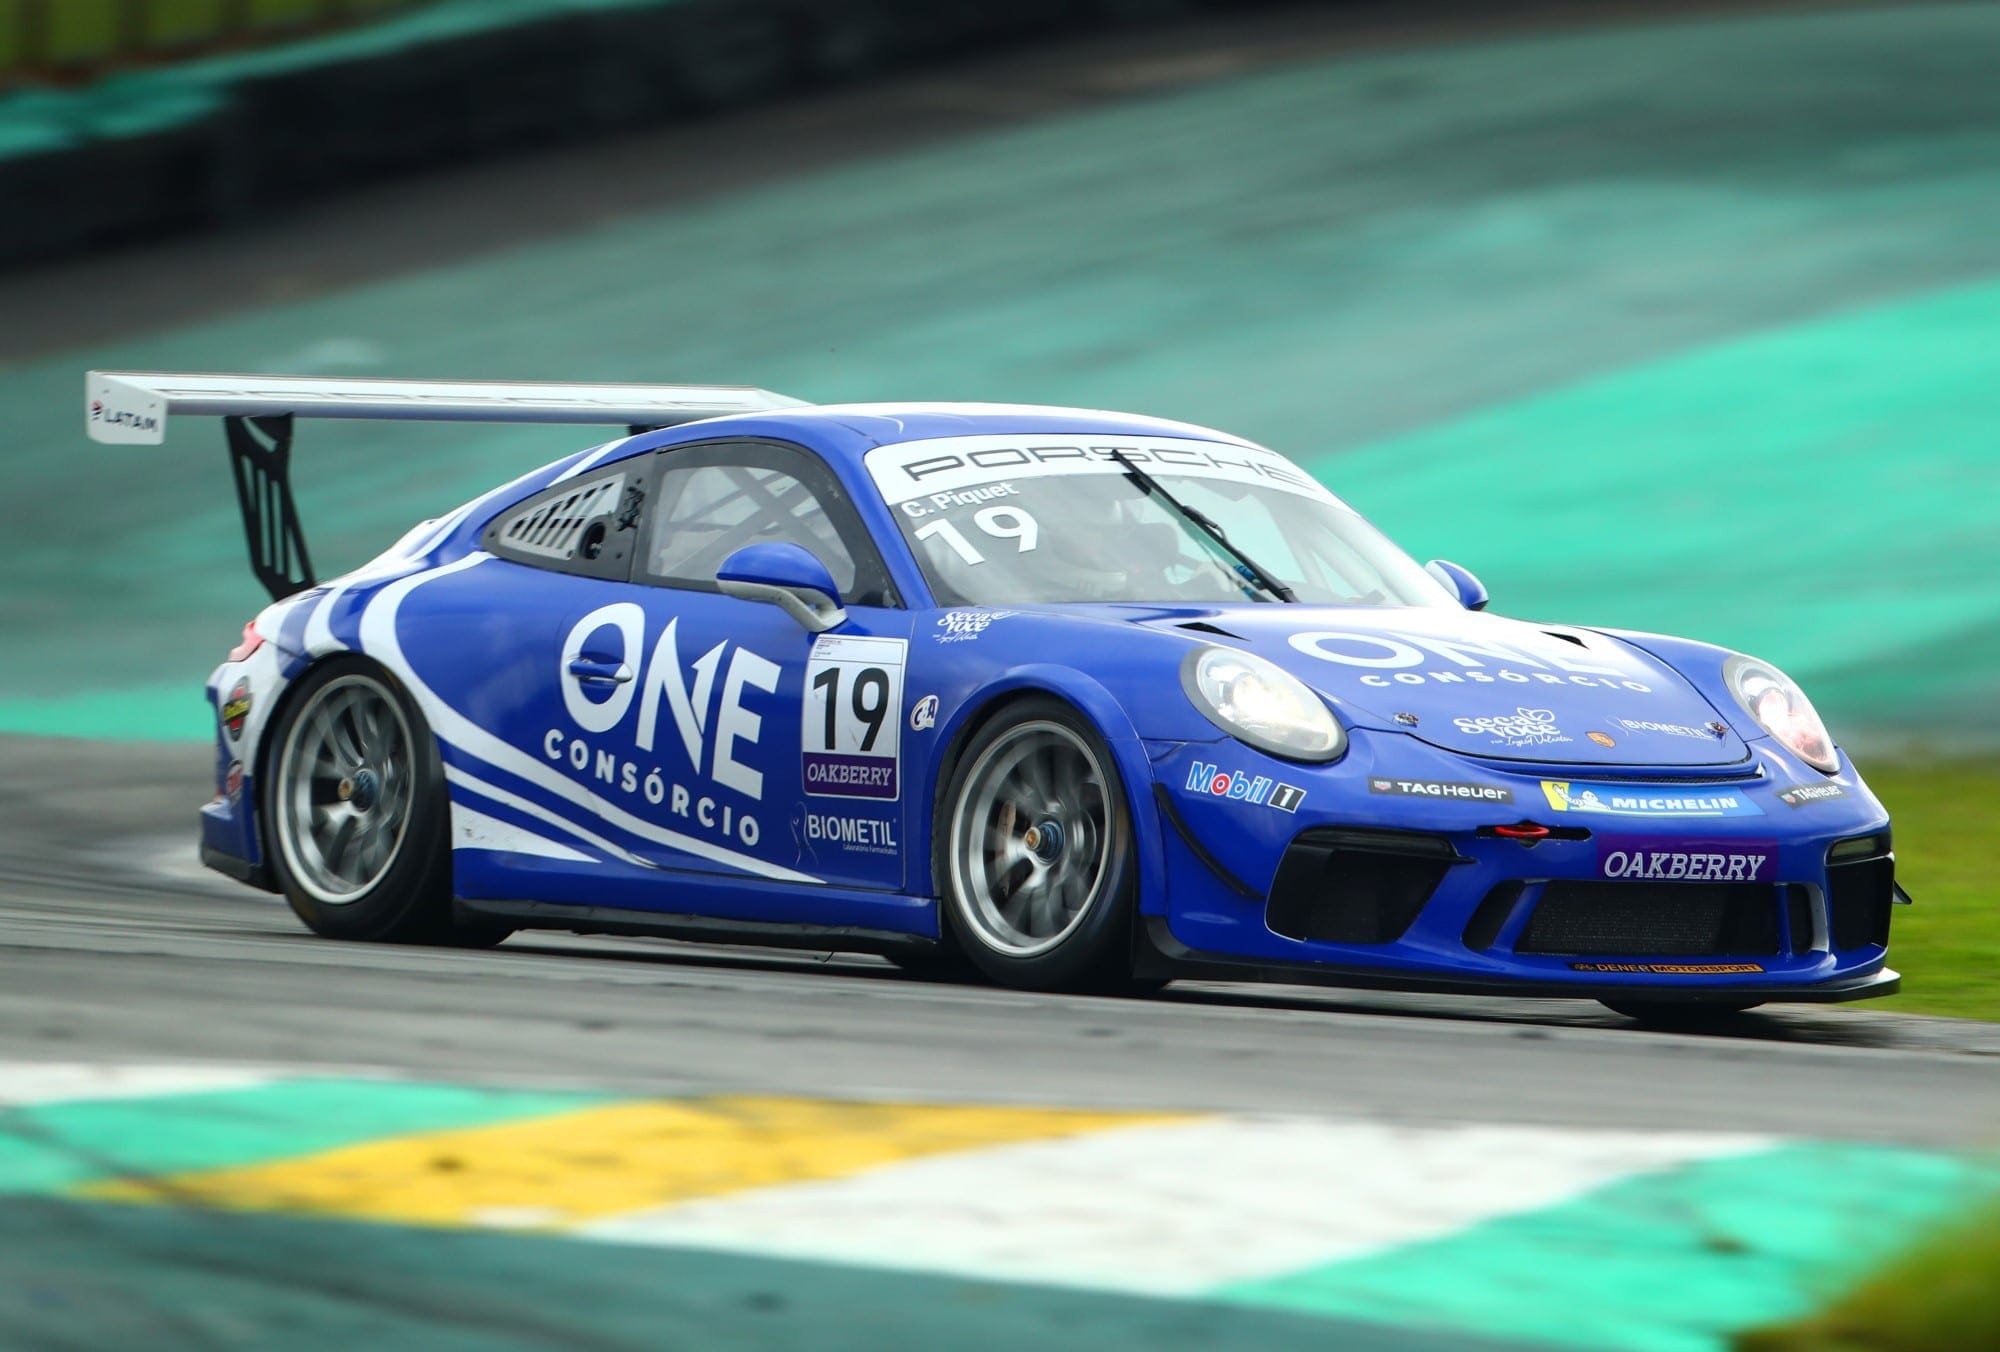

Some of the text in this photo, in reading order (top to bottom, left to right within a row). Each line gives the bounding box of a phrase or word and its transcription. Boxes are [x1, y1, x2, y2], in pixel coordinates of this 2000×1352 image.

[104, 408, 158, 432] LATAM
[901, 446, 1316, 491] PORSCHE
[901, 481, 1019, 518] C. Piquet
[914, 505, 1038, 566] 19
[1360, 669, 1652, 692] CONSÓRCIO
[560, 602, 782, 801] ONE
[813, 667, 890, 752] 19
[544, 729, 759, 846] CONSÓRCIO
[807, 763, 893, 786] OAKBERRY
[1184, 761, 1272, 804] Mobil
[1612, 797, 1738, 809] MICHELIN
[807, 814, 897, 846] BIOMETIL
[1604, 852, 1766, 881] OAKBERRY
[1596, 963, 1758, 973] DENER MOTORSPORT
